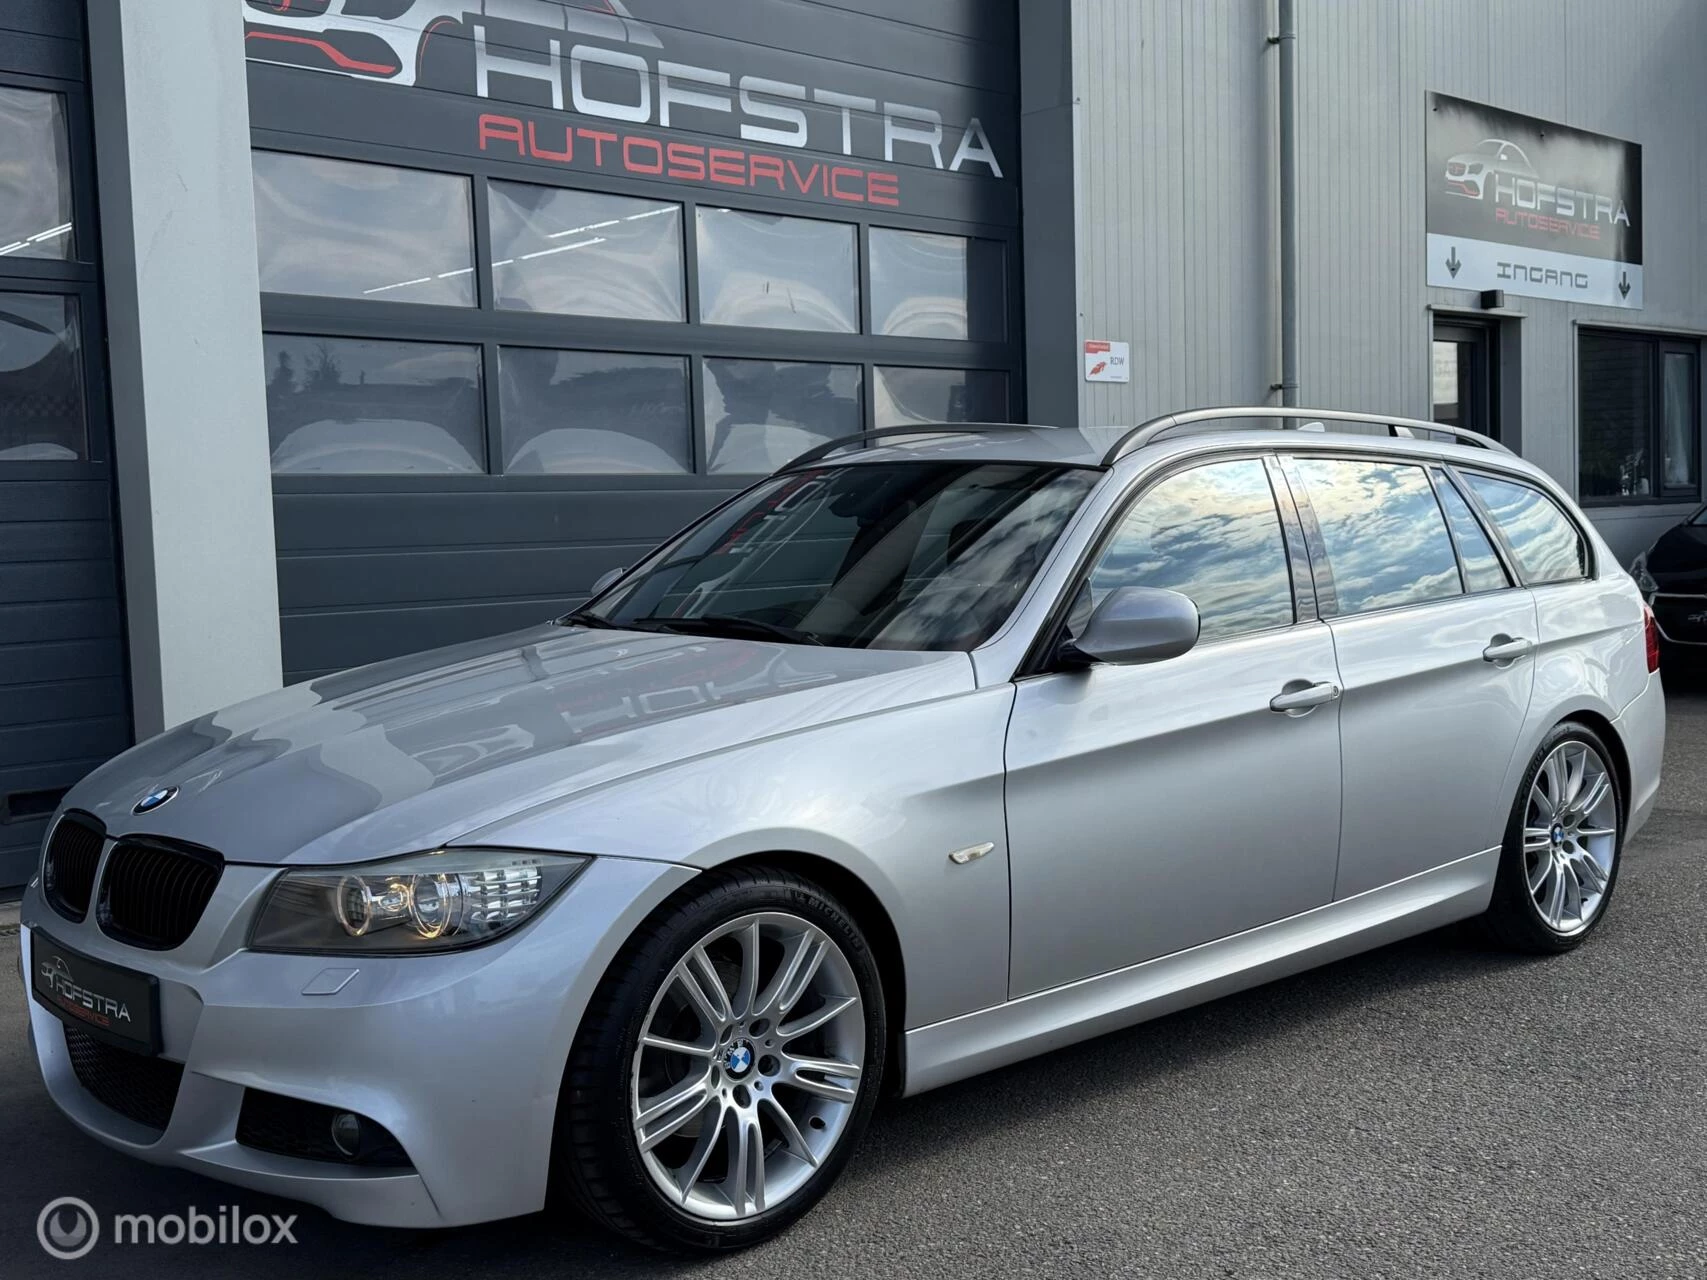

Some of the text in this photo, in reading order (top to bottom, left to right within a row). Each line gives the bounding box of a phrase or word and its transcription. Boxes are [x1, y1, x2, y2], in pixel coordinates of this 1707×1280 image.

[474, 24, 1004, 178] HOFSTRA
[478, 113, 900, 206] AUTOSERVICE
[1495, 173, 1630, 227] HOFSTRA
[1495, 208, 1601, 240] AUTOSERVICE
[1110, 356, 1125, 366] RDW
[55, 975, 131, 1022] HOFSTRA
